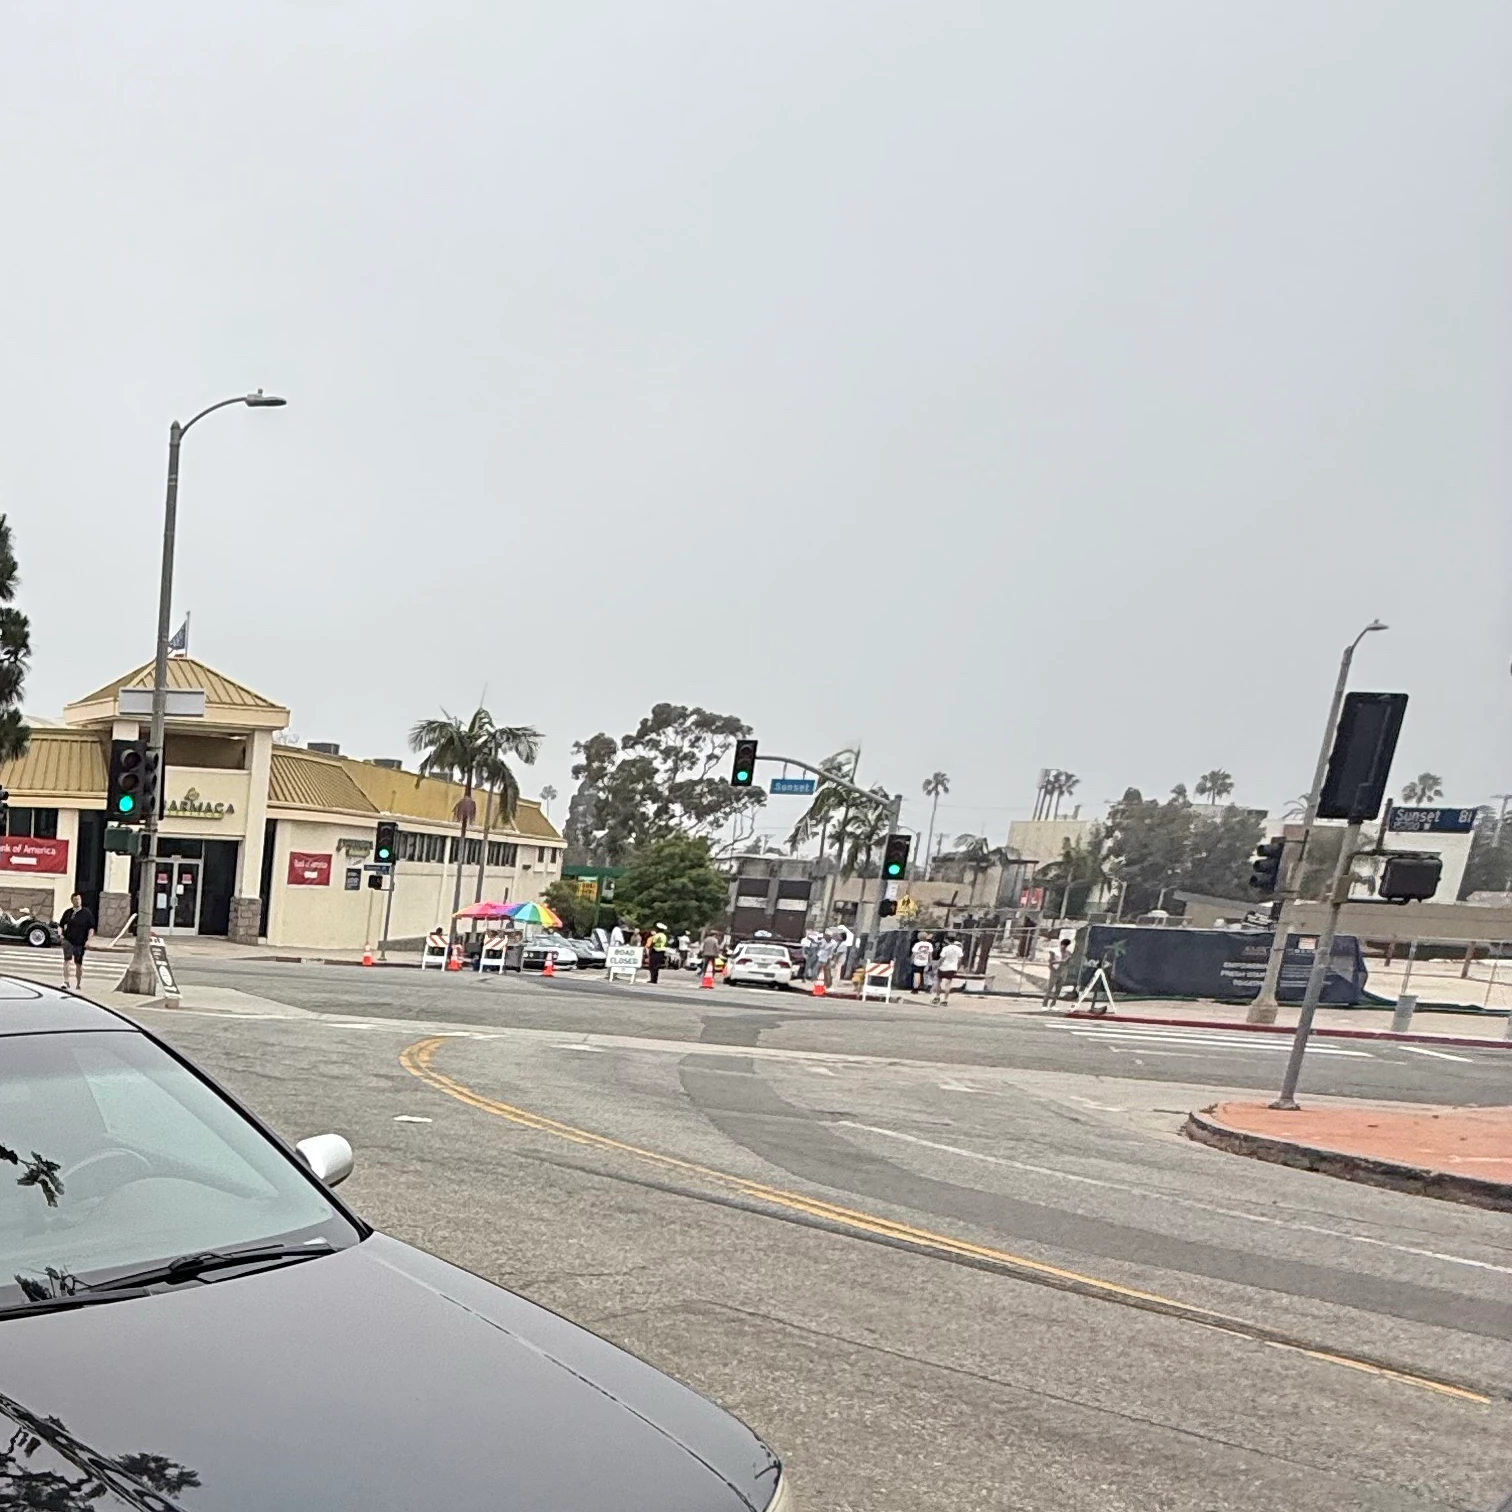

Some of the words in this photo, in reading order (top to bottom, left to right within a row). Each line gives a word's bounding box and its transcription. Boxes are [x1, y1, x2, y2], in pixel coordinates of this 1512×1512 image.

[774, 782, 810, 792] Sunset
[164, 800, 235, 815] ARMACA
[1395, 808, 1441, 823] Sunset
[12, 845, 23, 854] of
[23, 845, 57, 856] America
[610, 957, 639, 965] CLOSED
